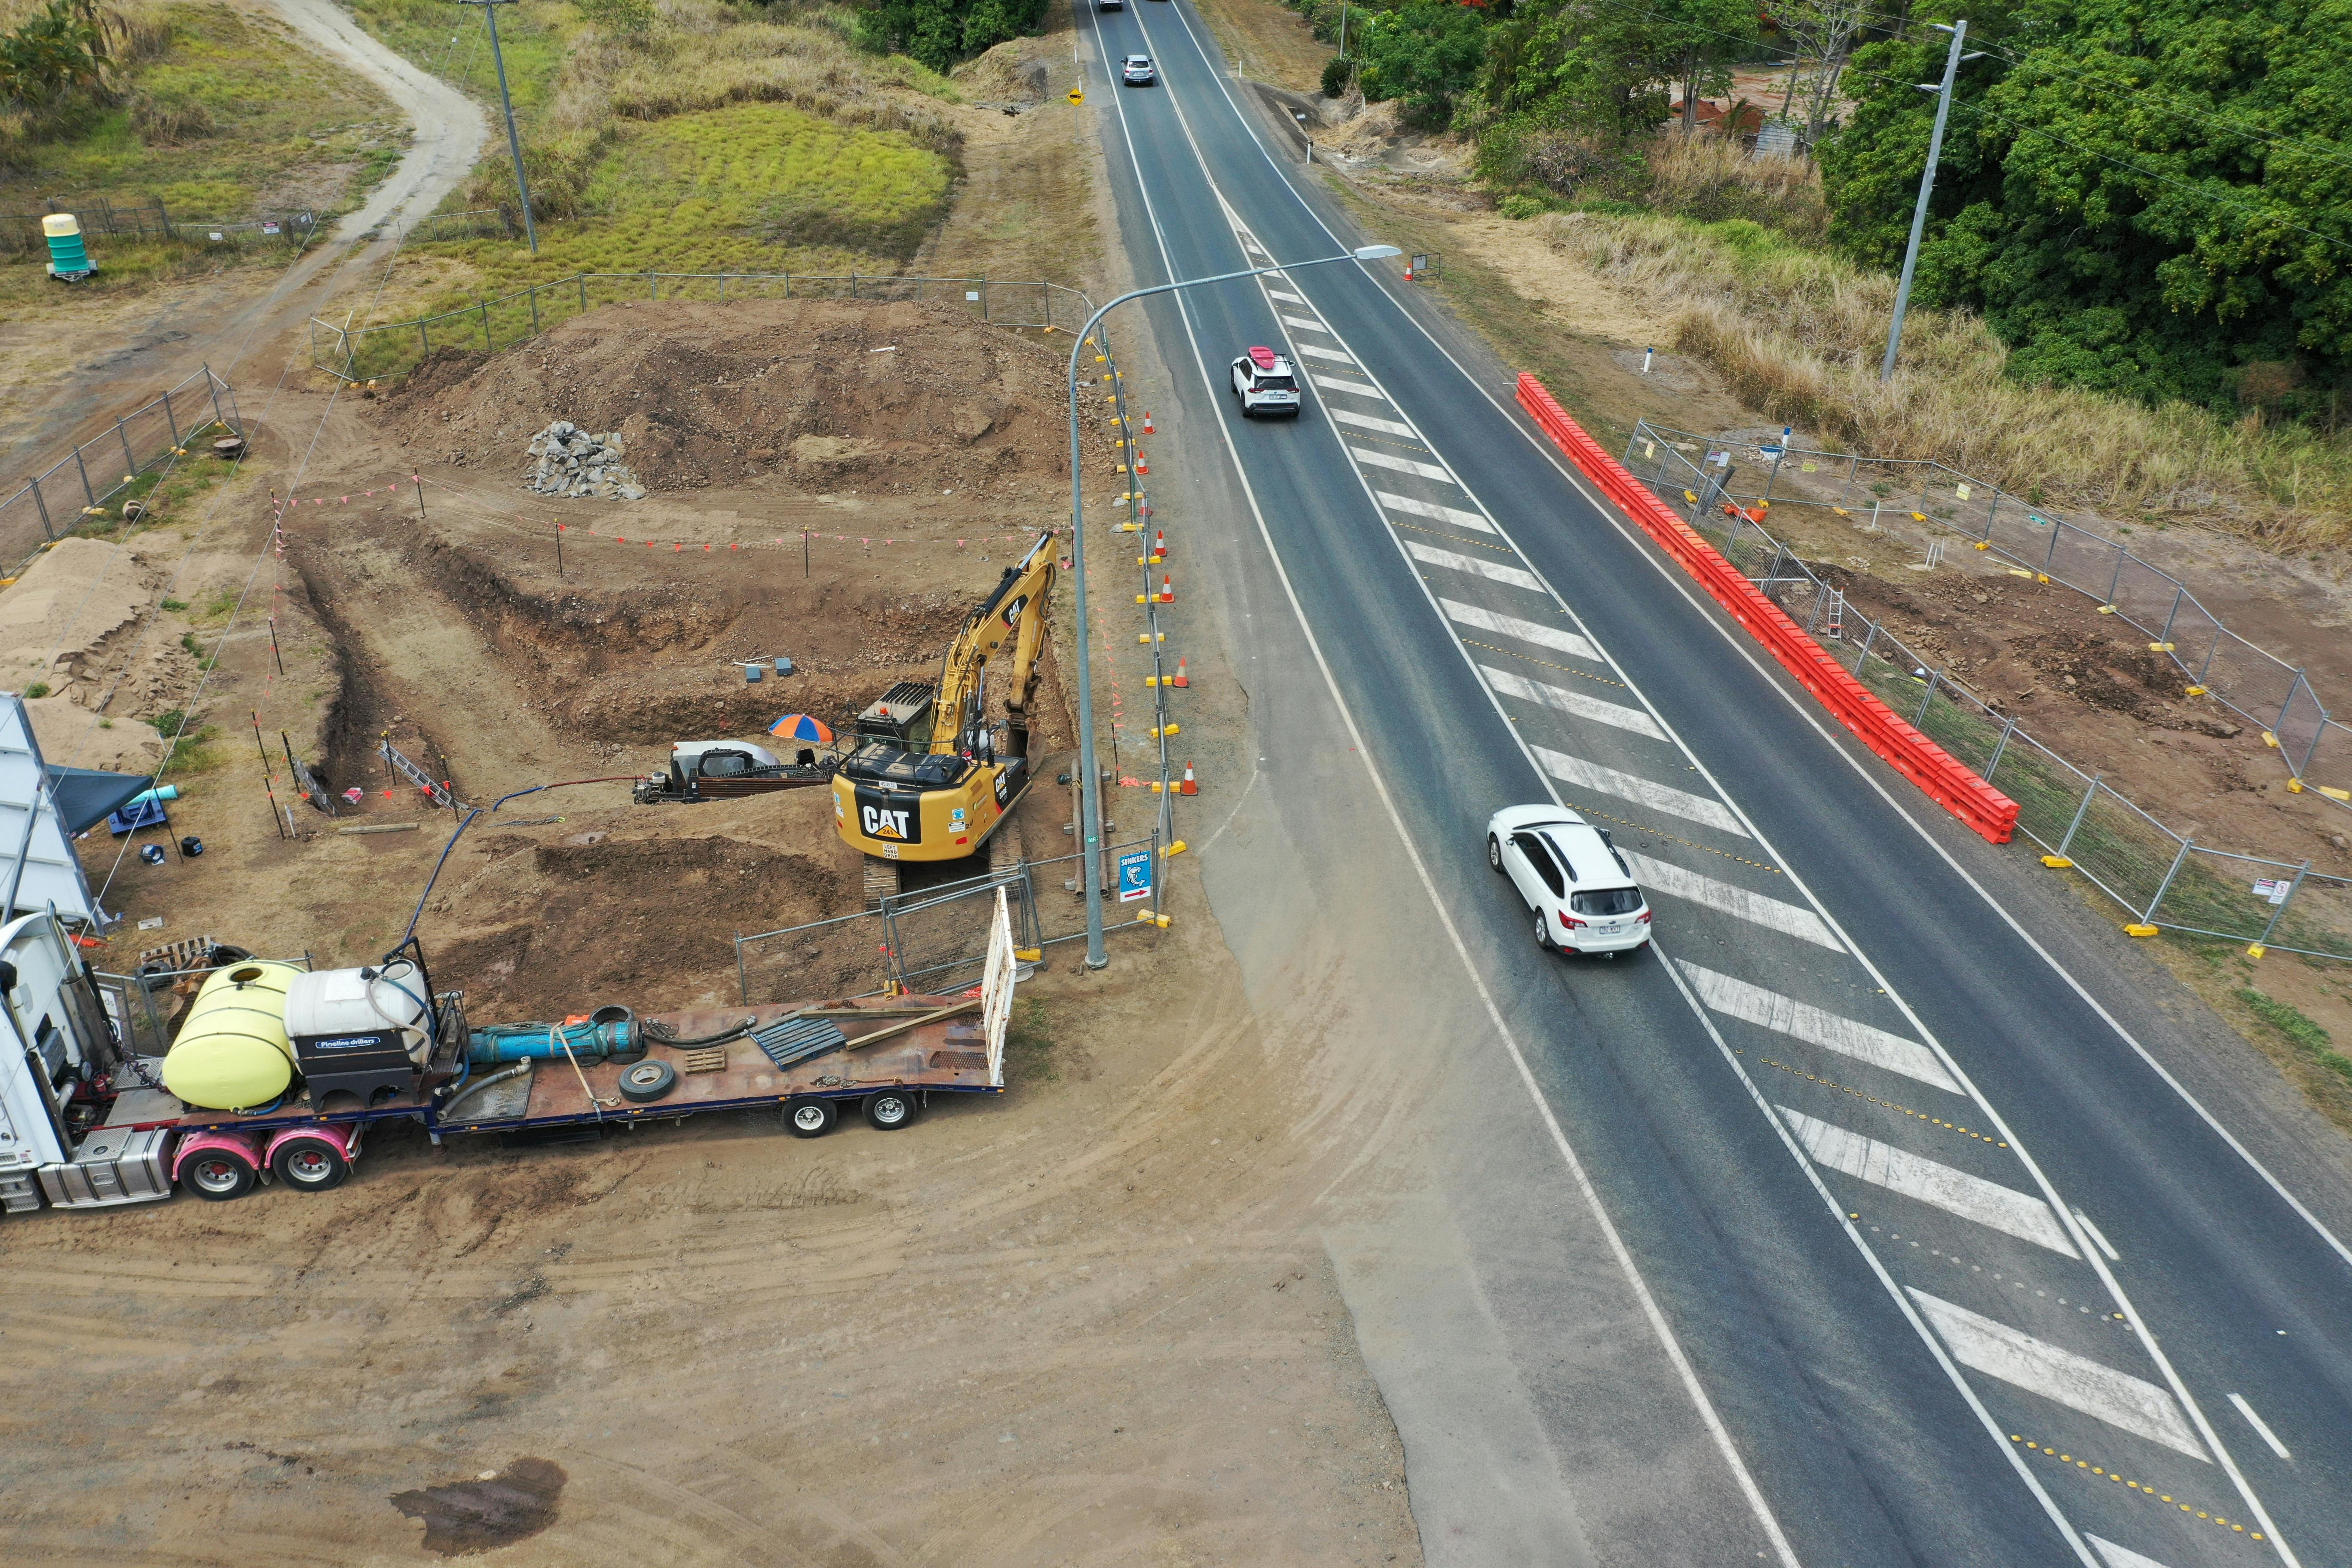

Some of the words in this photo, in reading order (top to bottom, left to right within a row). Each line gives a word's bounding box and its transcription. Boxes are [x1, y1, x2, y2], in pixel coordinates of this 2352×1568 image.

[1009, 599, 1020, 623] CAT
[995, 772, 1006, 792] CAT
[863, 805, 909, 839] CAT
[1121, 854, 1148, 866] SINKERS
